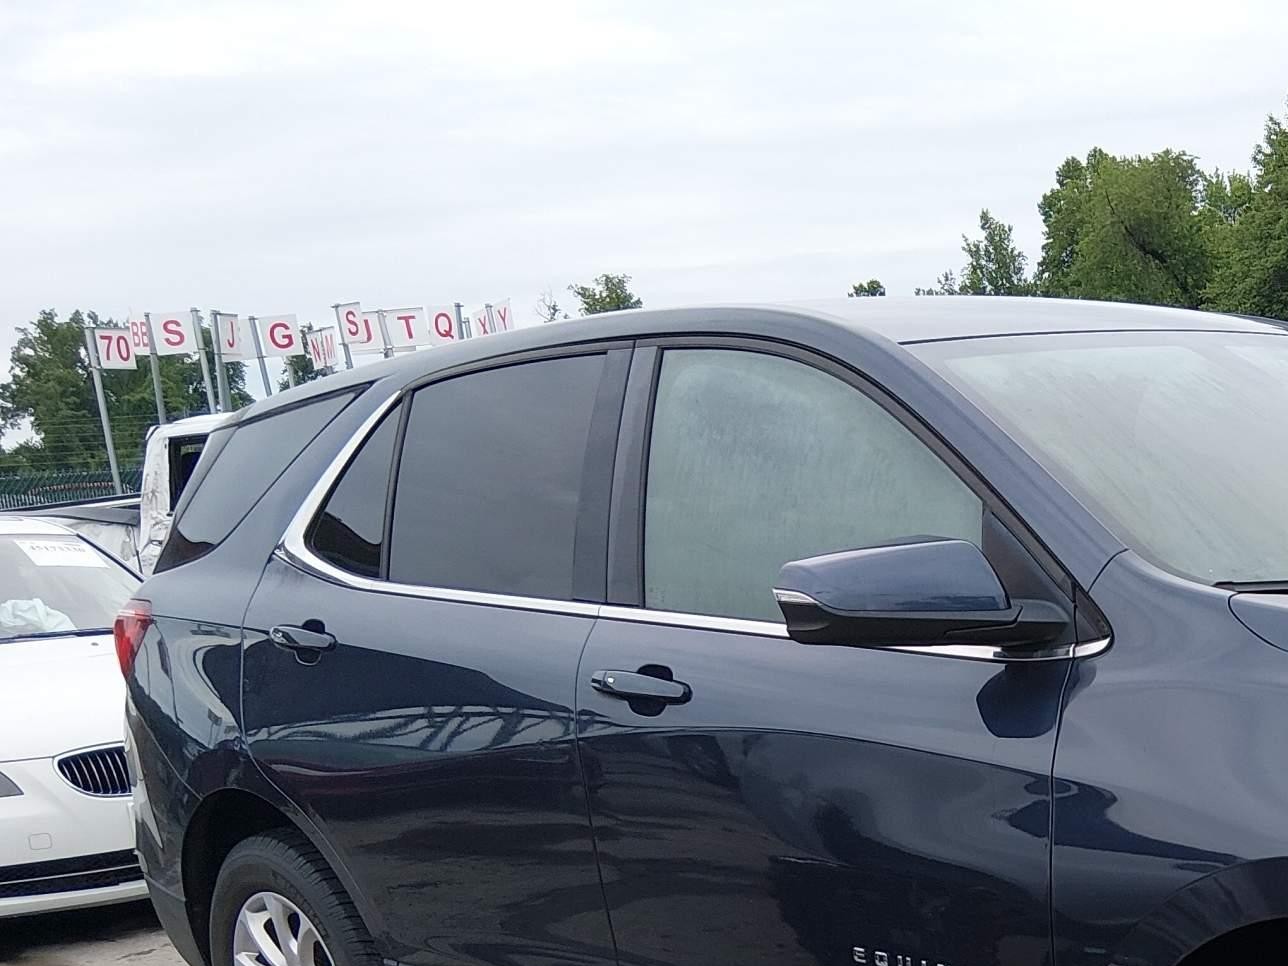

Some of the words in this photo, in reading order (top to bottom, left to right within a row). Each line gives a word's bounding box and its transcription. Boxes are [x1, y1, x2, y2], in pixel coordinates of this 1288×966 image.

[162, 319, 186, 347] S
[227, 321, 235, 348] J
[269, 322, 294, 349] G
[345, 310, 359, 336] S
[397, 315, 416, 339] T
[434, 312, 454, 340] Q
[100, 334, 131, 362] 70
